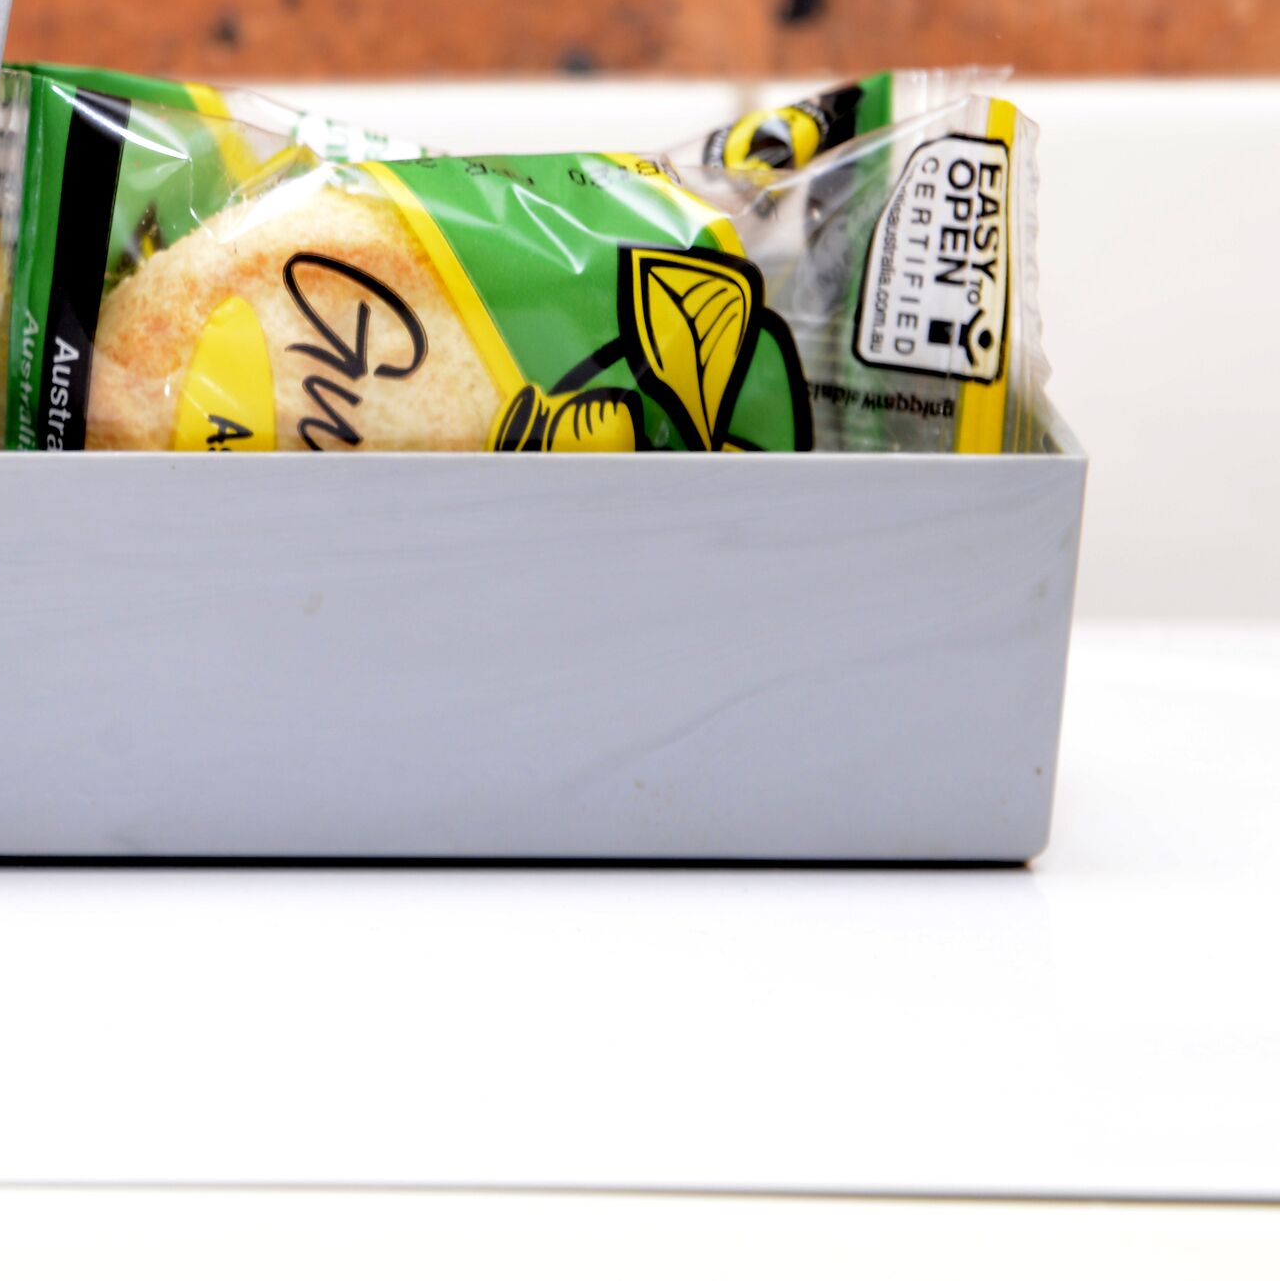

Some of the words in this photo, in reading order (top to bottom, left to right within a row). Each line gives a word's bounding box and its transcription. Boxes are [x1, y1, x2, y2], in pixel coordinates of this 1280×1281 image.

[894, 157, 939, 356] CERTIFIED
[934, 158, 976, 286] OPEN
[971, 162, 1002, 284] EASY
[967, 278, 983, 306] TO
[16, 307, 40, 451] Australi
